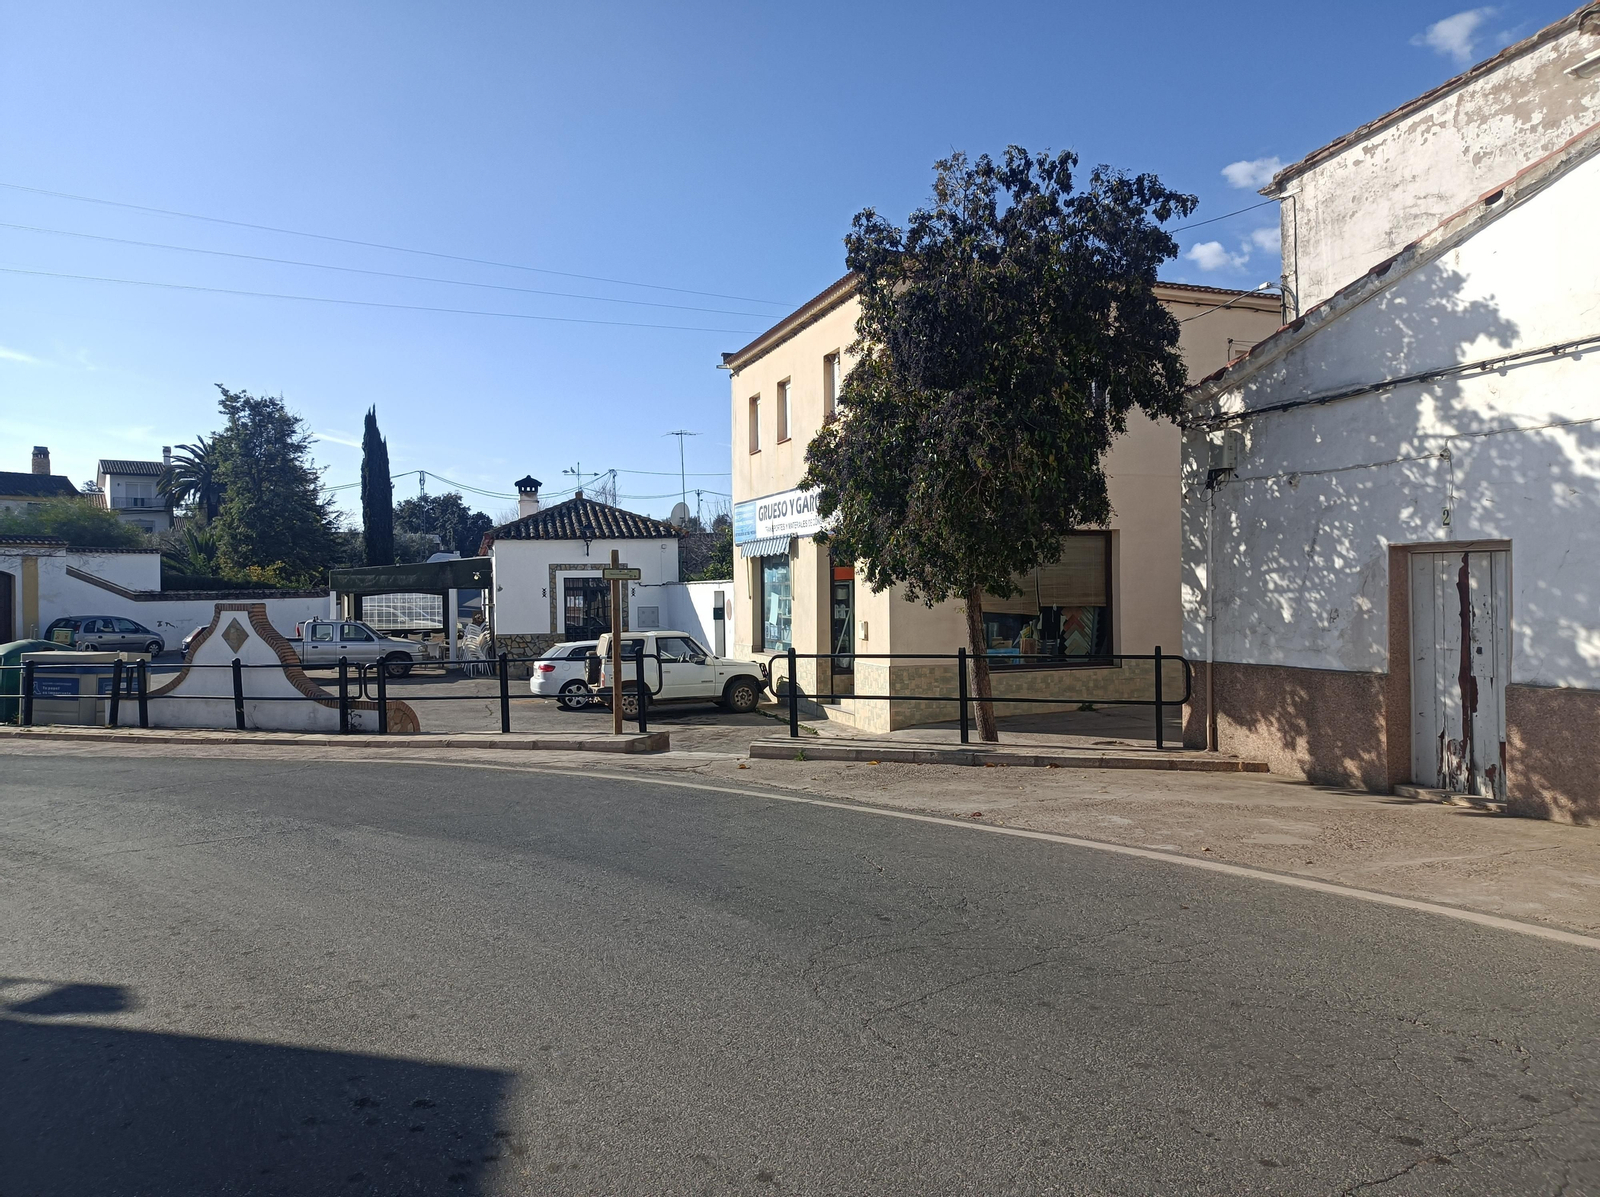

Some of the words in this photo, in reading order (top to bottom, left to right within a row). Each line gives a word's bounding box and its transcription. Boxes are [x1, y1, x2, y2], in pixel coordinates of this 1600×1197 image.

[758, 500, 788, 521] GRUESO
[789, 498, 797, 515] Y
[795, 492, 820, 514] GARC
[1442, 509, 1450, 526] 2
